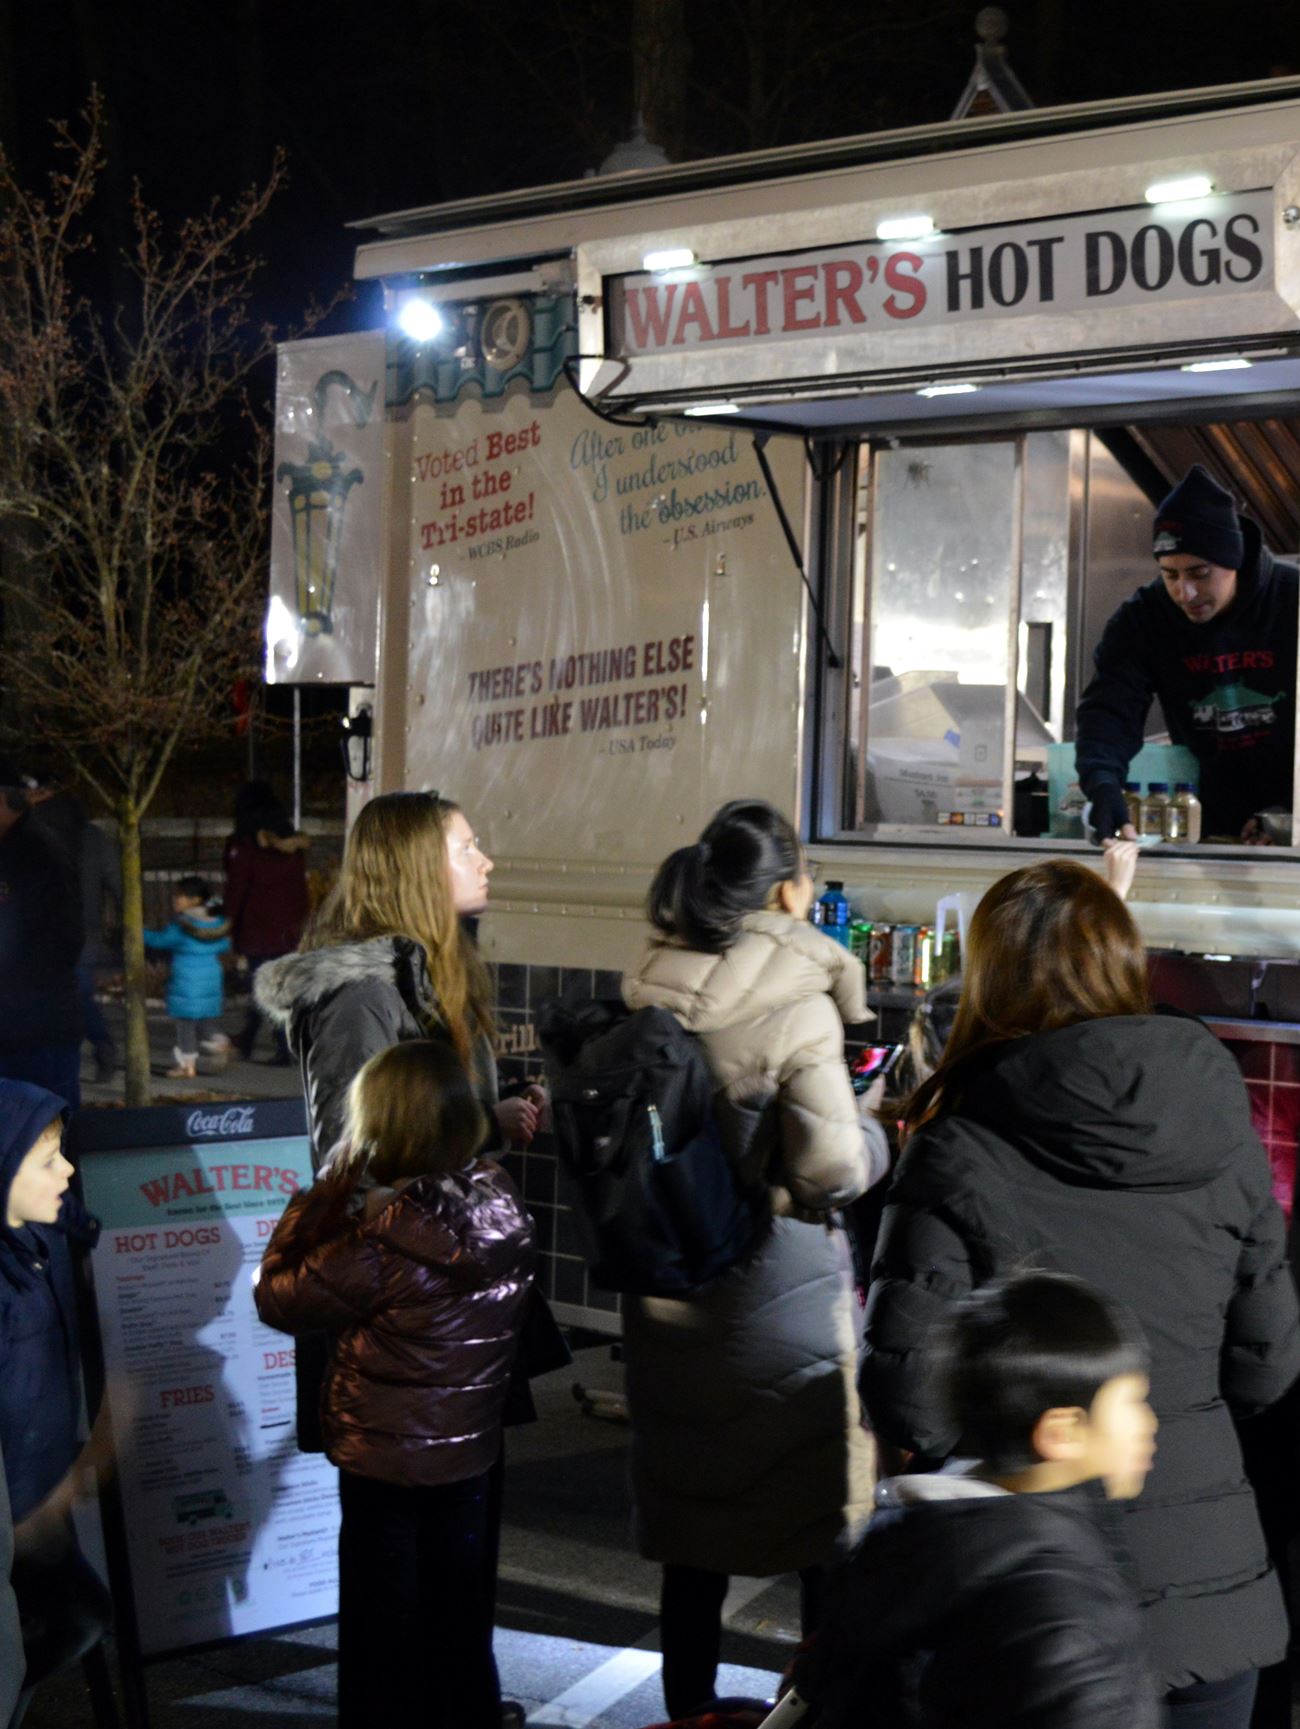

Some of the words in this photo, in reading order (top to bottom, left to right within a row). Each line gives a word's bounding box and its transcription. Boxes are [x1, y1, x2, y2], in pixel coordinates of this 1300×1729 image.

[624, 251, 928, 348] WALTER'S
[945, 235, 1064, 313] HOT
[1084, 213, 1264, 297] DOGS
[416, 439, 480, 483] Voted
[486, 420, 541, 461] Best
[570, 429, 625, 473] After
[616, 432, 737, 496] understood
[440, 481, 466, 510] in
[472, 469, 512, 500] the
[619, 503, 652, 536] the
[659, 480, 767, 526] obsession.
[421, 492, 535, 550] Tri-state!
[702, 512, 755, 538] Airways
[468, 538, 504, 561] WCBS
[505, 531, 541, 551] Radio
[468, 660, 544, 704] THERE'S
[549, 645, 636, 692] NOTHING
[643, 635, 696, 676] ELSE
[530, 701, 572, 740] LIKE
[580, 684, 688, 732] WALTER'S!
[639, 733, 677, 752] Today
[140, 1164, 301, 1207] WALTER'S
[114, 1233, 157, 1254] HOT
[164, 1226, 221, 1249] DOGS
[160, 1384, 215, 1408] FRIES
